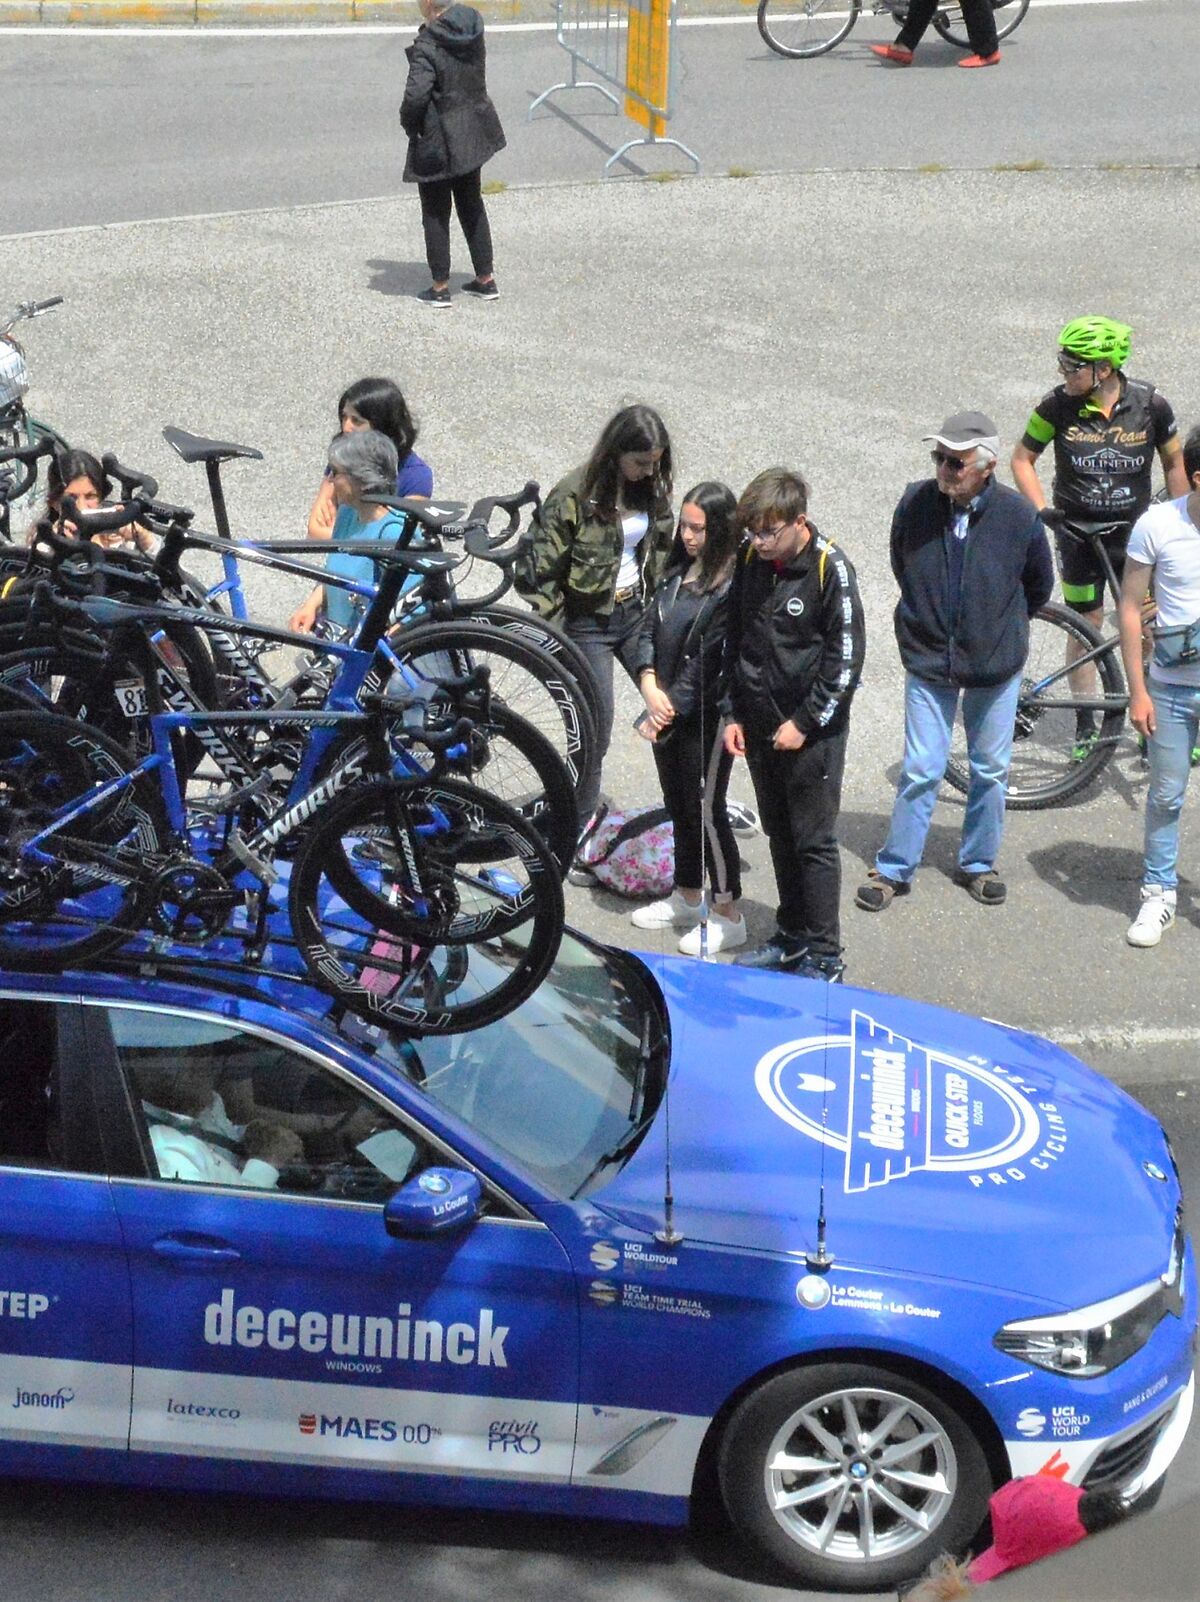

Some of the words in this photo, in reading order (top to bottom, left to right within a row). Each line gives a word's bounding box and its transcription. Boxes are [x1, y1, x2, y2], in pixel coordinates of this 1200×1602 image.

[967, 1054, 1037, 1095] TEAM
[944, 1101, 969, 1148] QUICK
[1030, 1101, 1067, 1170] CYCLING
[968, 1166, 1027, 1187] PRO
[623, 1242, 643, 1253] UCI
[623, 1251, 678, 1266] WORLDTOUR
[623, 1284, 643, 1293] UCI
[623, 1292, 650, 1302] TEAM
[652, 1295, 674, 1306] TIME
[677, 1298, 703, 1309] TRIAL
[203, 1287, 511, 1368] deceuninck
[325, 1360, 383, 1374] WINDOWS
[166, 1398, 241, 1421] latexco
[1052, 1406, 1075, 1417] UCI
[319, 1413, 398, 1442] MAES
[1051, 1414, 1091, 1427] WORLD
[1051, 1426, 1081, 1437] TOUR
[487, 1431, 543, 1455] PRO
